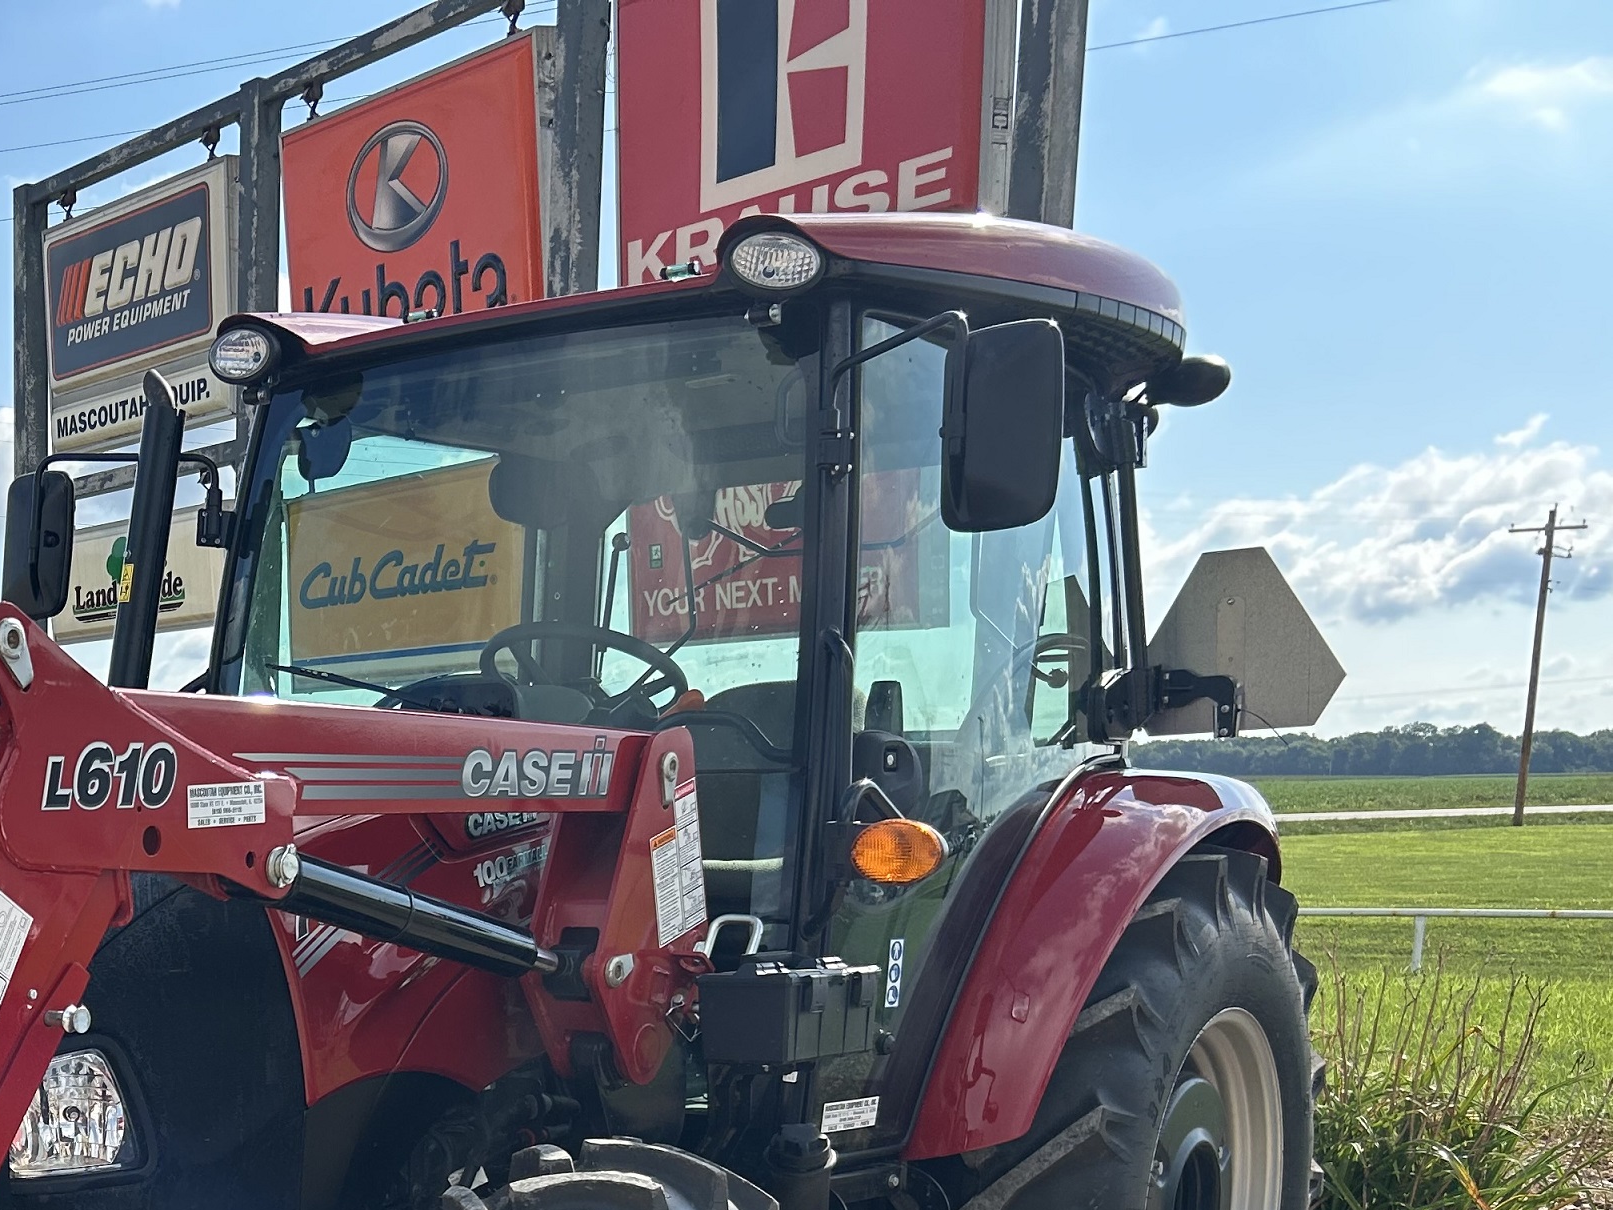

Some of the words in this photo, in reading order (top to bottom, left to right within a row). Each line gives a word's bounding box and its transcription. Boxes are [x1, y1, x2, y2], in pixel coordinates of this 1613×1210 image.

[627, 146, 953, 286] KRSE
[84, 216, 202, 318] ECHO
[67, 316, 111, 347] POWER
[112, 289, 191, 332] EQUIPMENT
[57, 396, 152, 438] MASCOUTAH
[74, 579, 118, 610] Land
[299, 557, 367, 610] Cub
[369, 539, 497, 600] Cadet
[643, 587, 705, 617] YOUR
[716, 577, 778, 611] NEXT
[40, 740, 178, 811] L610
[462, 749, 576, 797] CASE
[473, 855, 507, 888] 100
